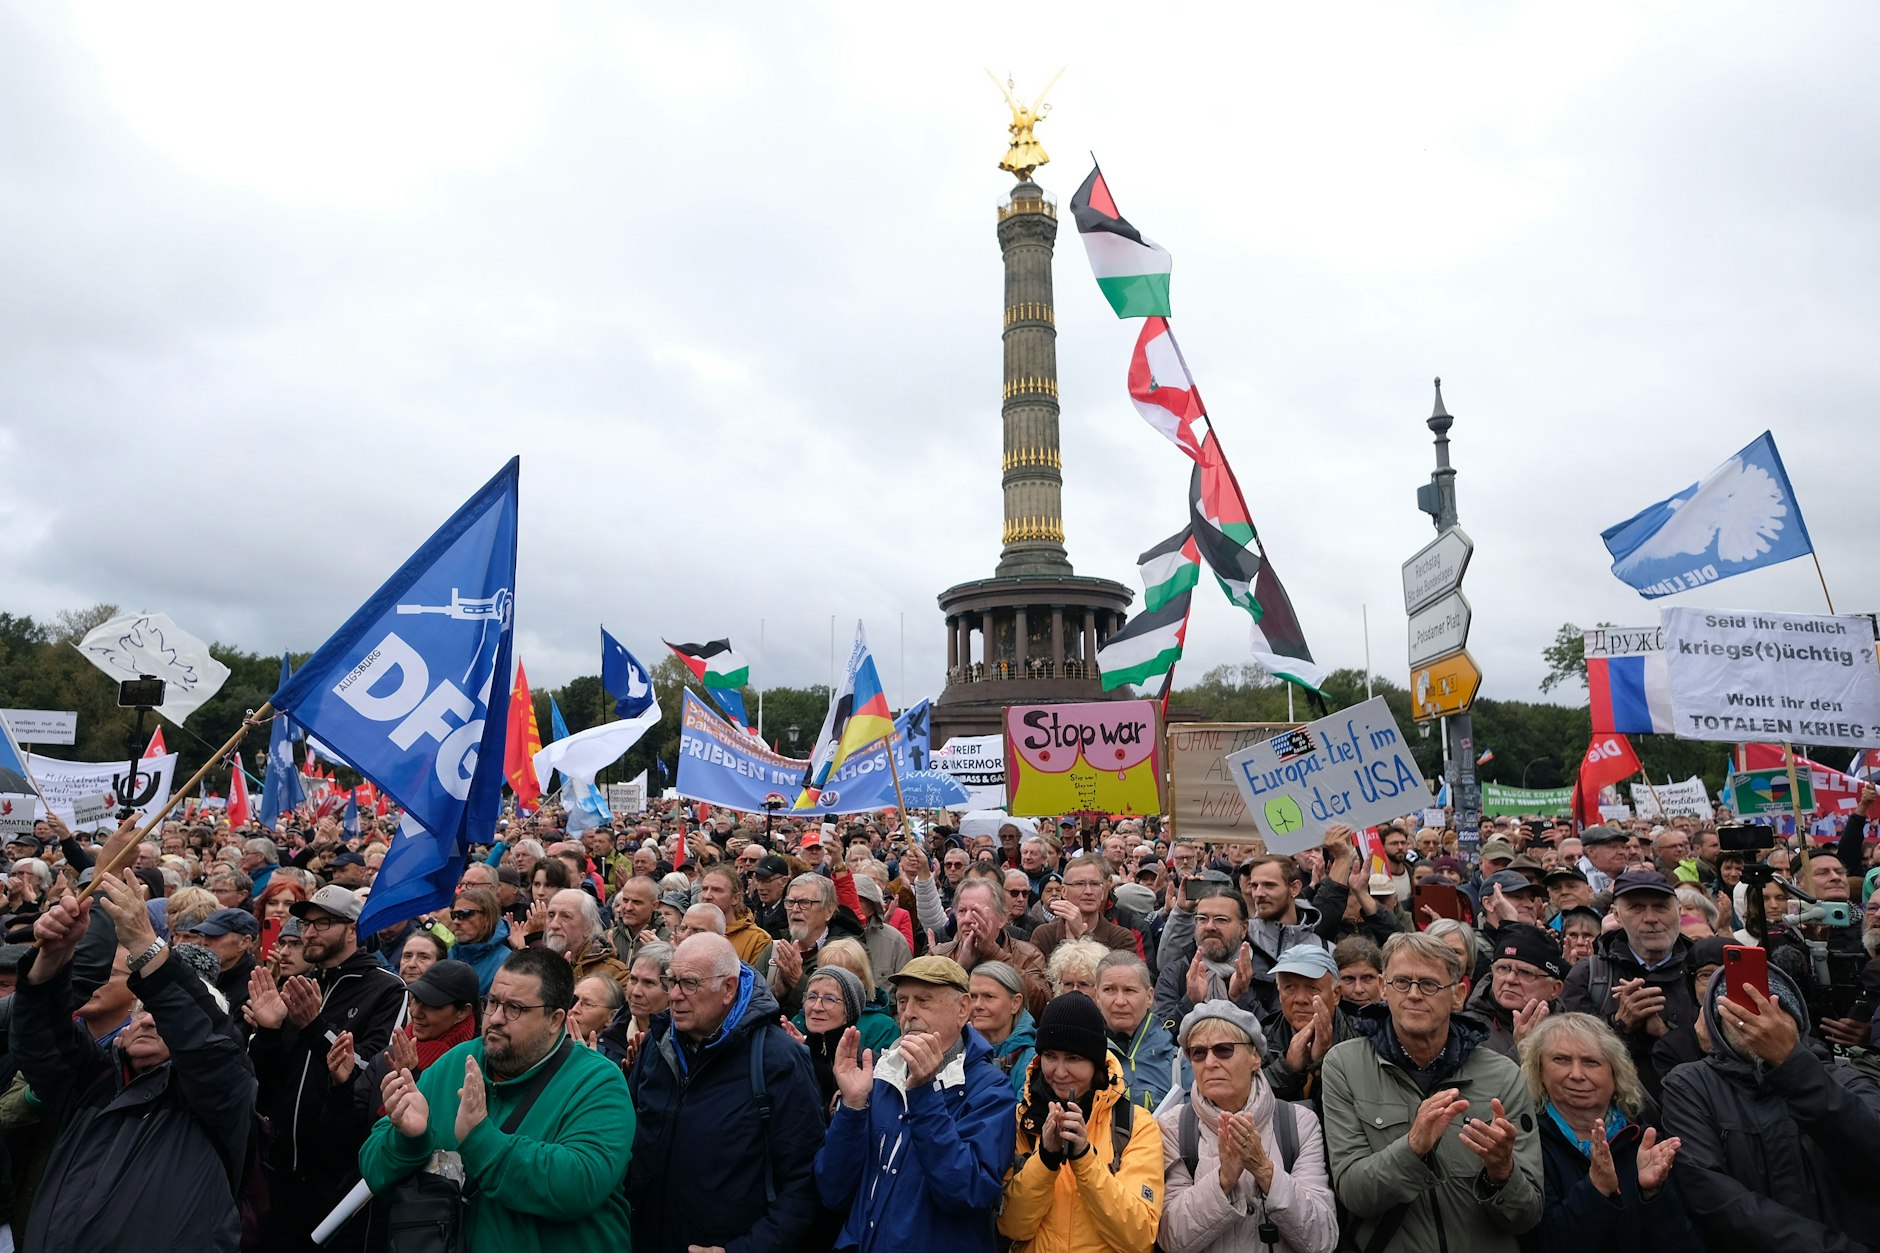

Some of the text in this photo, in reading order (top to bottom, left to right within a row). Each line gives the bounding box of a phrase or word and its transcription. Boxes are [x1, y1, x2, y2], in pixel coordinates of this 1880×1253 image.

[1415, 553, 1440, 580] Reichstag
[1416, 612, 1460, 645] Potsdamer Platz
[1705, 615, 1847, 634] Seid ihr endlich
[1679, 638, 1872, 667] kriegs(t)üchtig ?
[338, 649, 381, 692] AUGSBURG
[1726, 693, 1842, 712] Wollt ihr den
[1023, 710, 1147, 754] Stop war
[1365, 724, 1397, 751] im
[1689, 715, 1792, 734] TOTALEN
[1800, 721, 1865, 739] KRIEG
[952, 744, 982, 755] TREIBT
[1177, 730, 1222, 752] OHNE
[679, 734, 765, 781] FRIEDEN
[771, 770, 797, 786] IN
[982, 774, 990, 783] &
[1311, 786, 1352, 821] der
[1354, 754, 1418, 803] USA
[76, 812, 113, 825] FRIEDEN!
